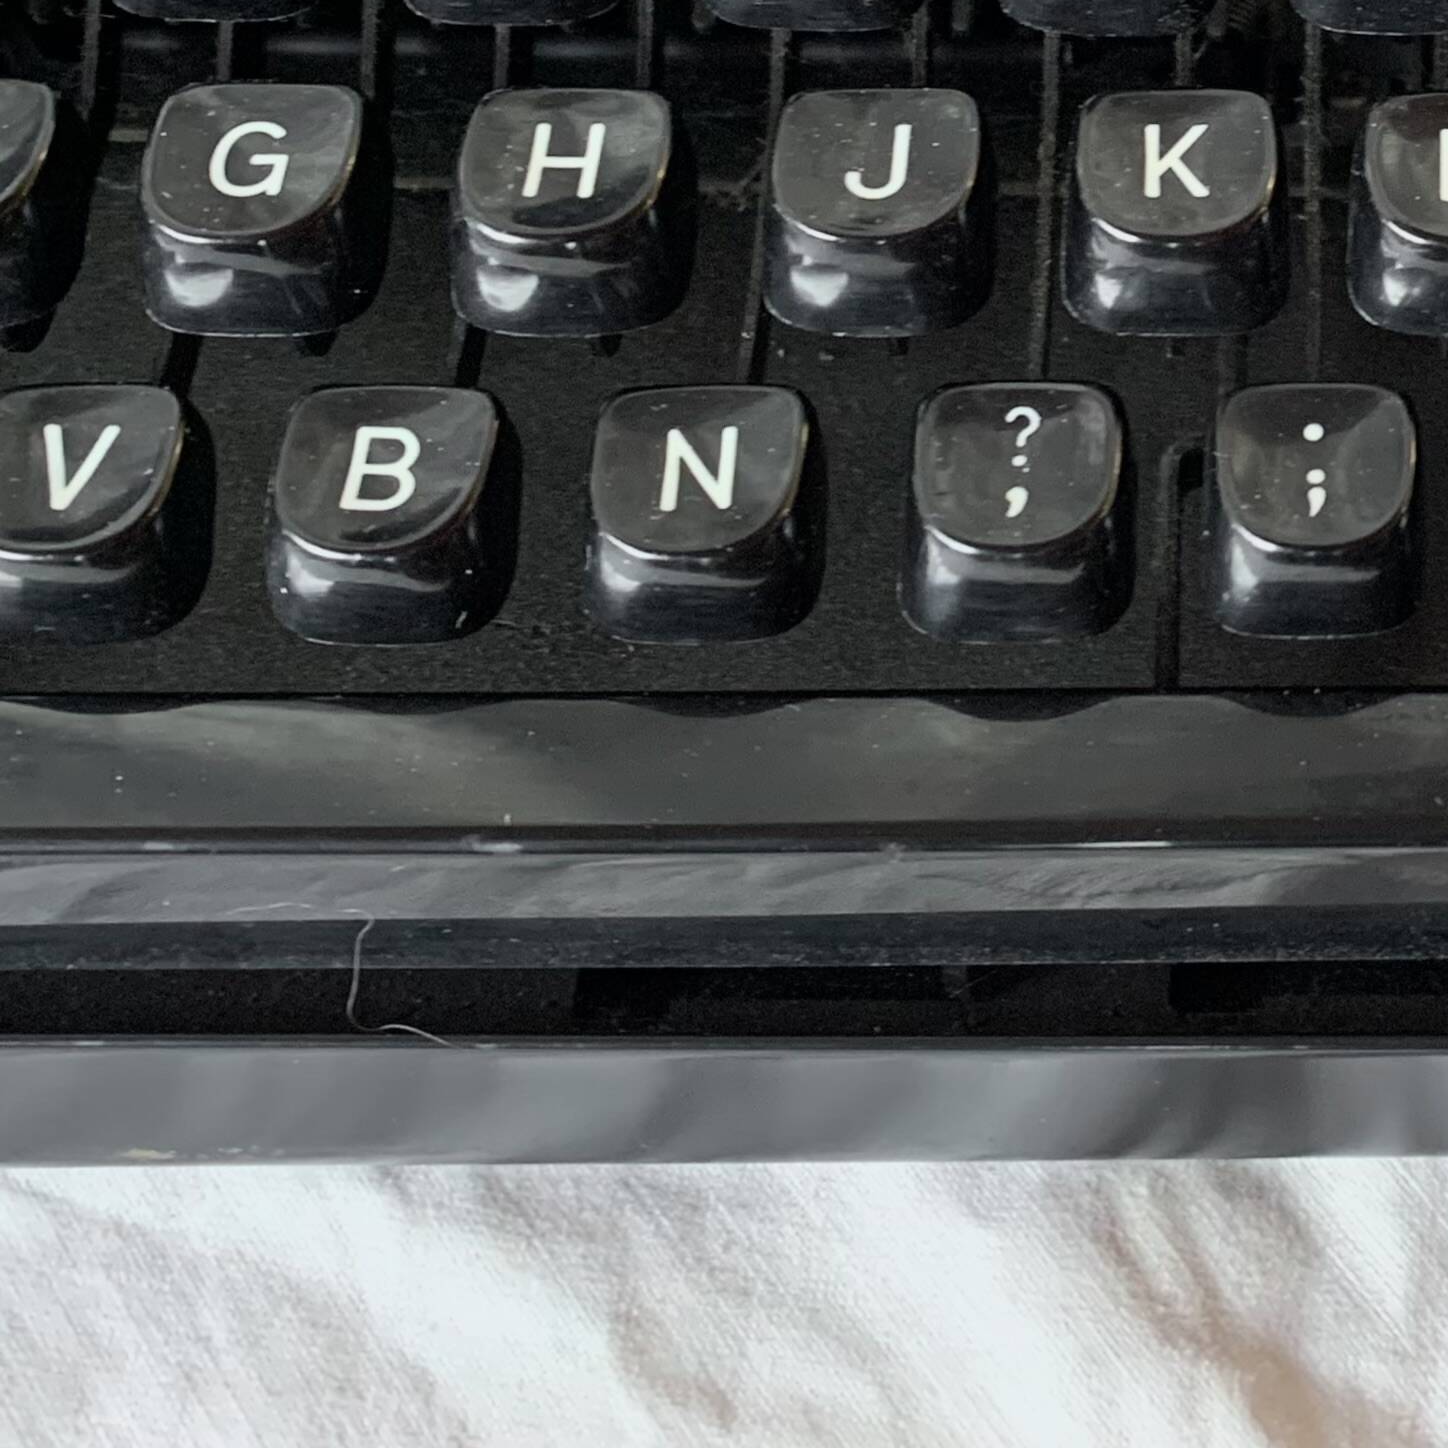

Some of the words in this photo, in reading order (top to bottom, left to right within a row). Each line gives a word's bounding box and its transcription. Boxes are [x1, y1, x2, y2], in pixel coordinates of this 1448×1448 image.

[209, 121, 289, 197] G
[522, 122, 606, 199] H
[844, 123, 912, 200] J
[1144, 124, 1210, 198] K
[43, 423, 121, 511] V
[339, 426, 421, 511] B
[659, 426, 738, 512] N
[1005, 406, 1042, 467] ?
